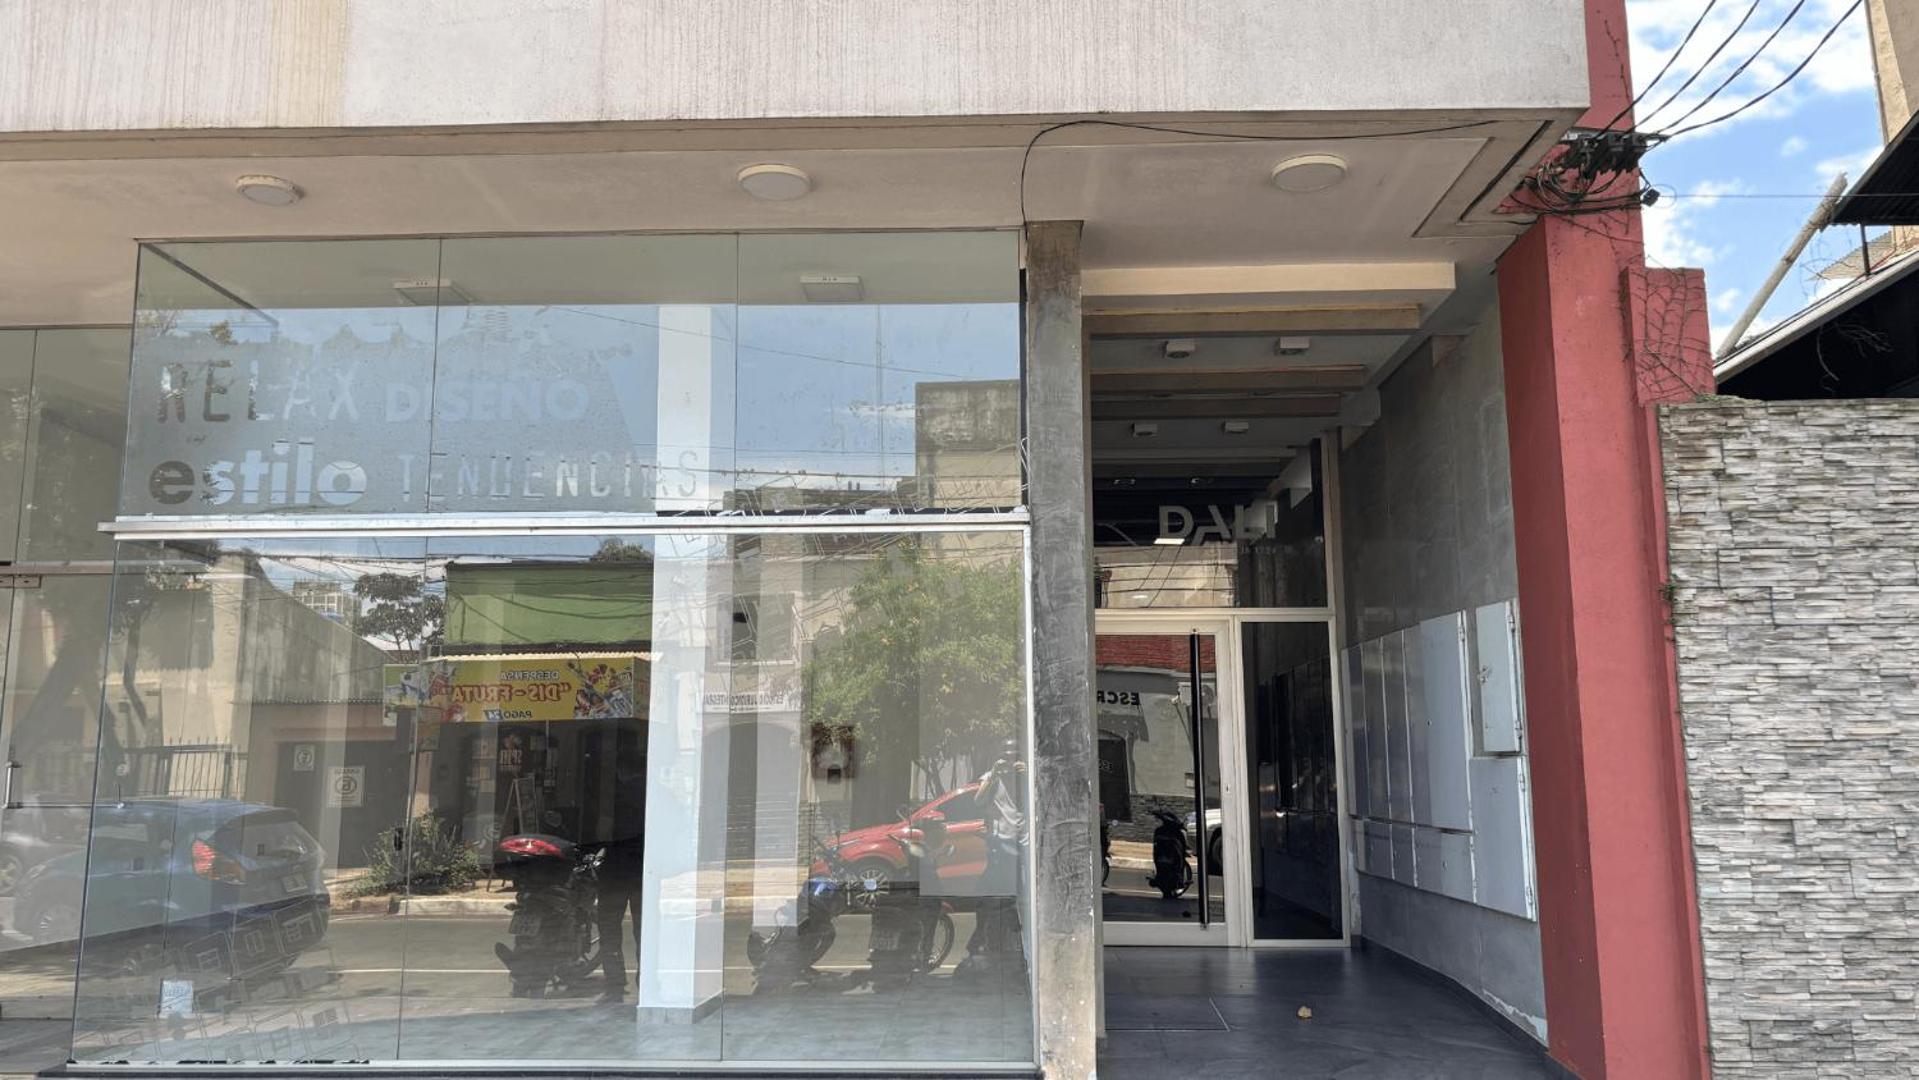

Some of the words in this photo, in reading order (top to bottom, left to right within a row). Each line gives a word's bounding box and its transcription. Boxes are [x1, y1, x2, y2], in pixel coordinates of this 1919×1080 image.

[157, 357, 361, 424] RELAX
[150, 438, 368, 506] estilo
[398, 450, 699, 502] TENDENCIAS
